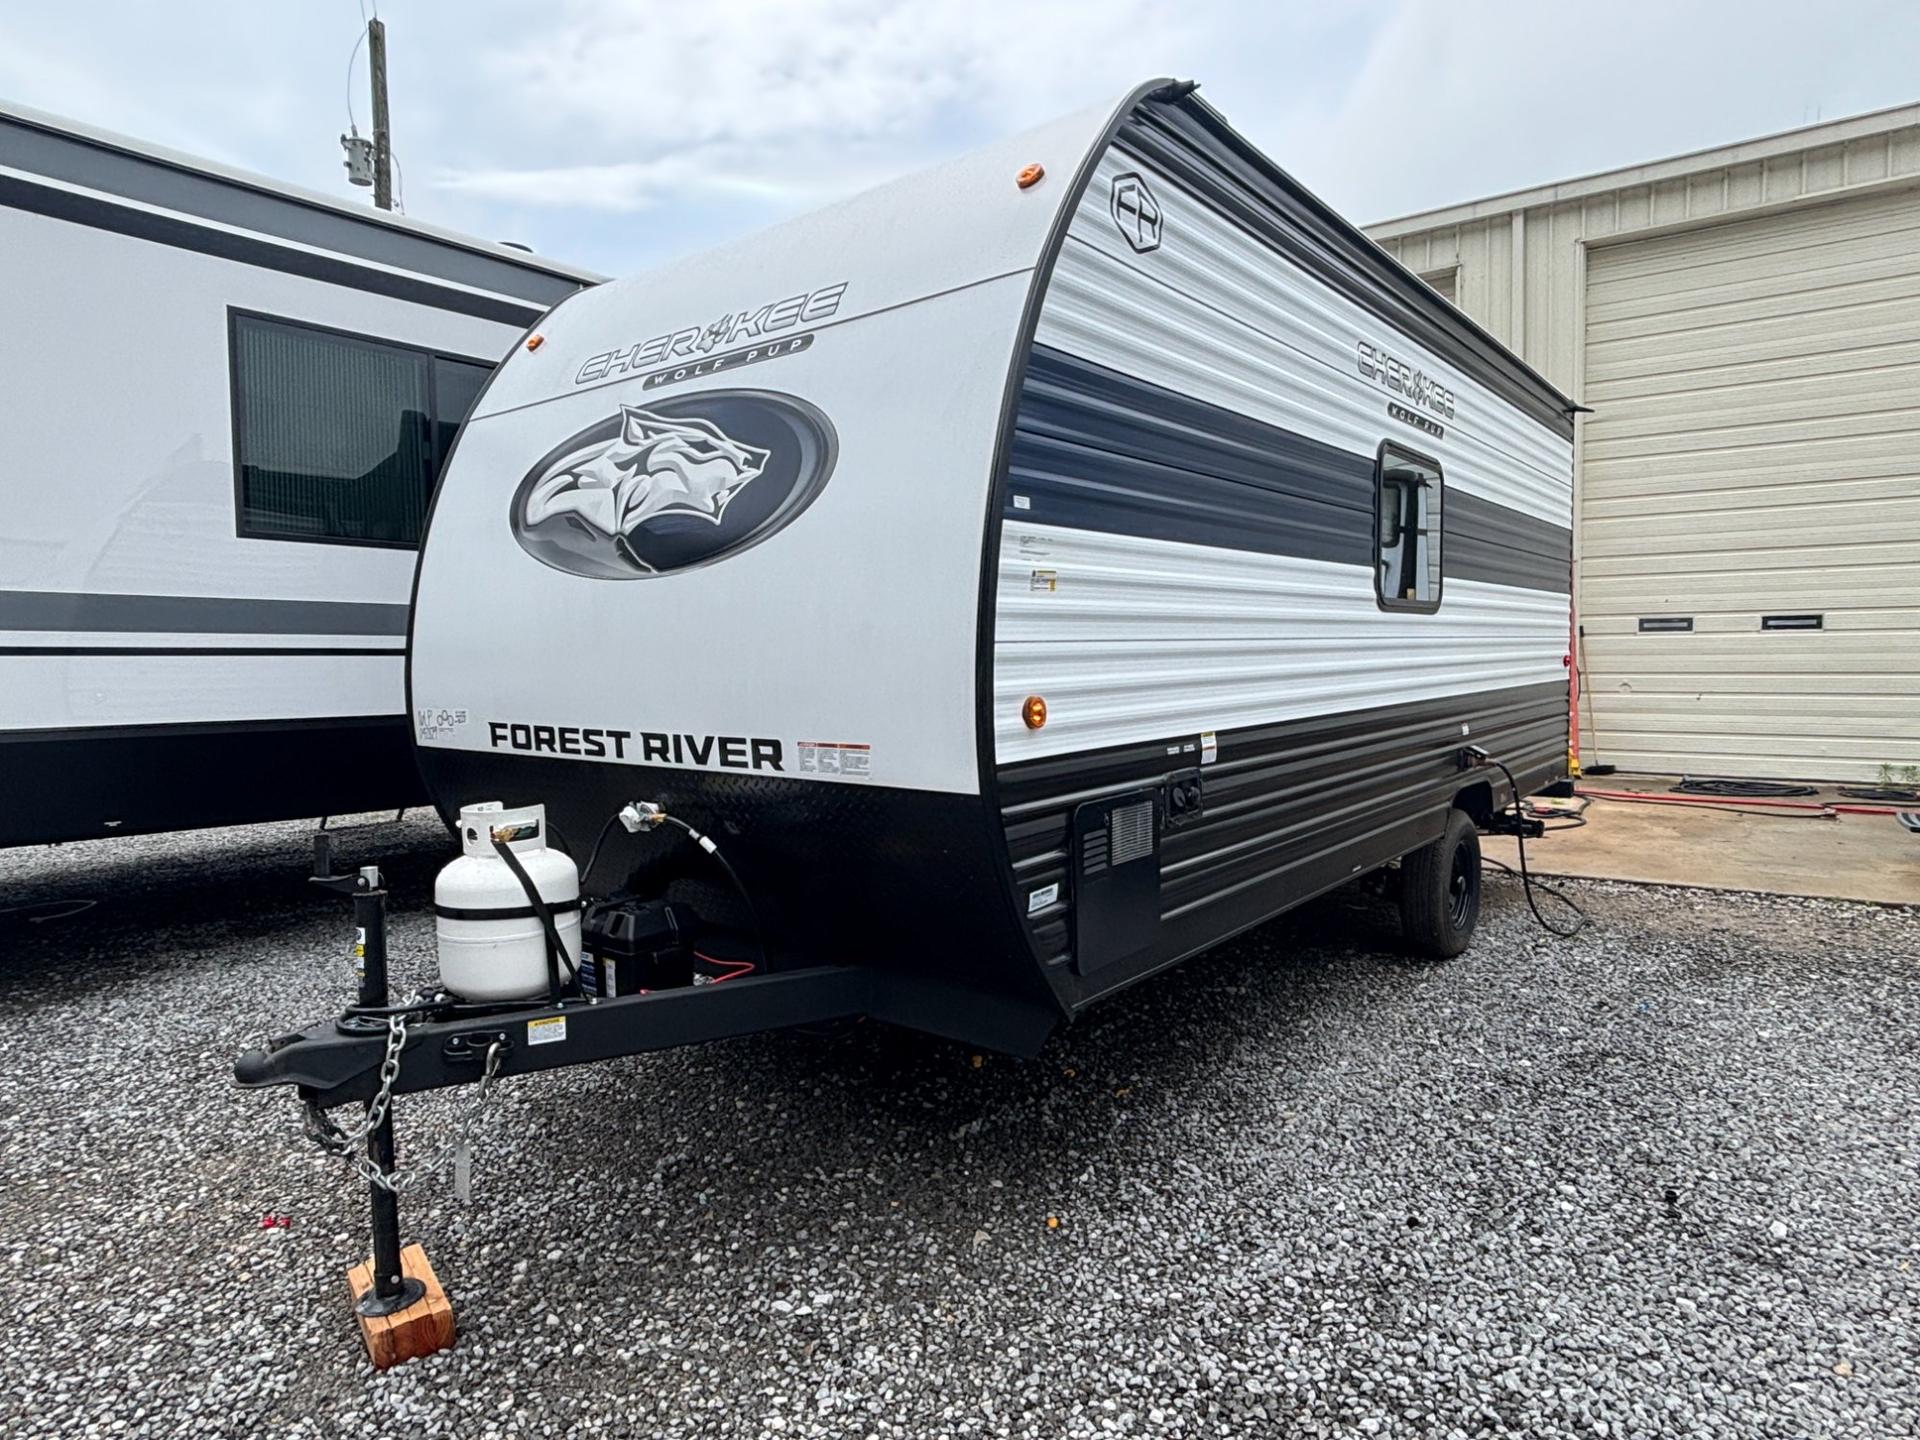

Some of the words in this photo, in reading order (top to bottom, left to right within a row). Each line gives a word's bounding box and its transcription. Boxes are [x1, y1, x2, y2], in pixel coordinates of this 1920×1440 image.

[653, 359, 724, 384] WOLF
[746, 340, 802, 362] PUP
[1392, 407, 1419, 425] WOLF
[1424, 423, 1442, 437] PUP
[488, 721, 631, 759] FOREST
[640, 732, 785, 771] RIVER
